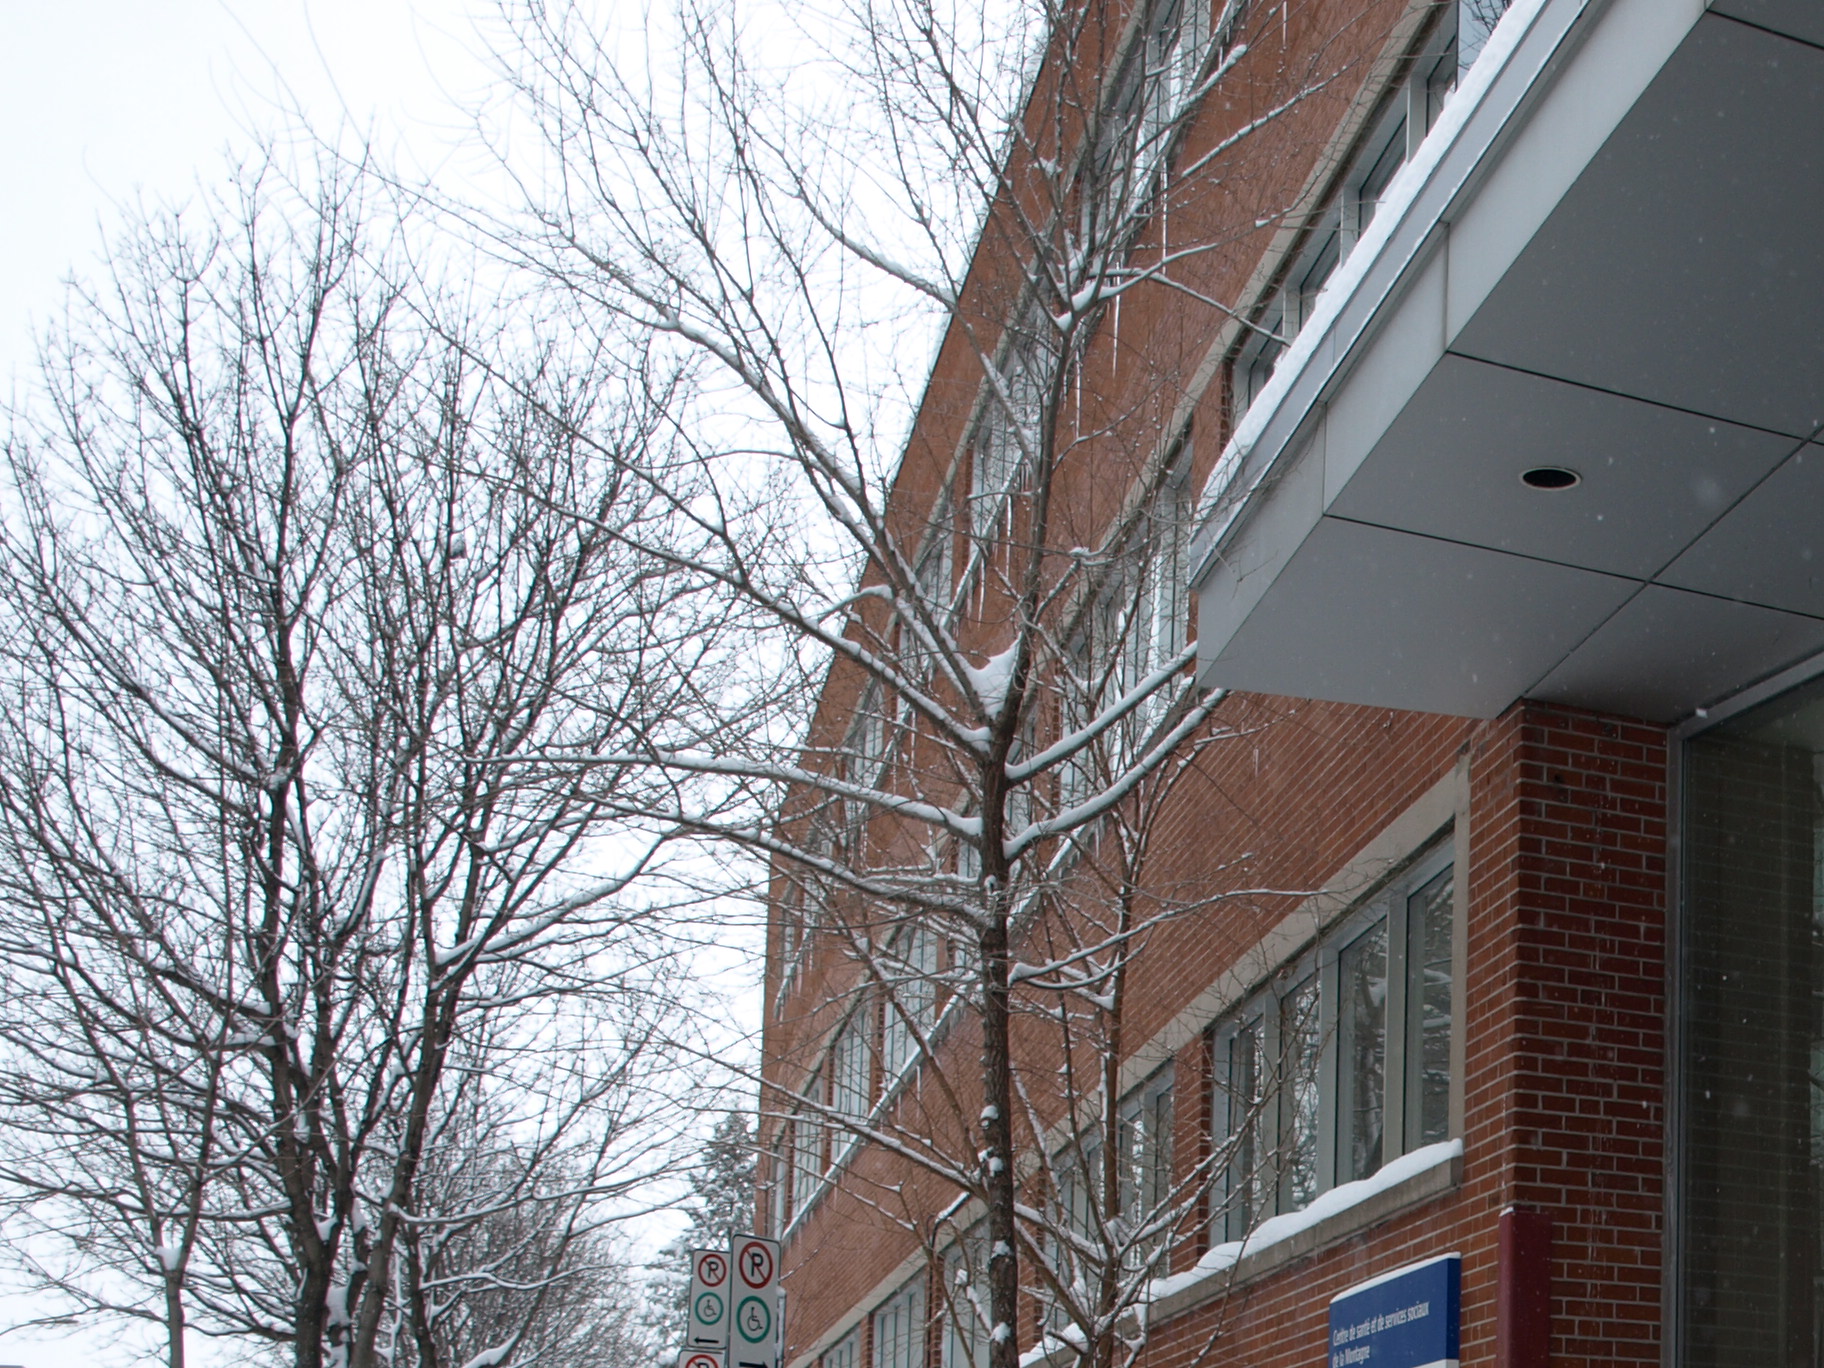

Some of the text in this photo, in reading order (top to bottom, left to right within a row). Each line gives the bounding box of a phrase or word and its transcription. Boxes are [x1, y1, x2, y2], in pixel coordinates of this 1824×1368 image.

[1333, 1327, 1349, 1347] Centre
[1349, 1323, 1356, 1341] de
[1356, 1317, 1370, 1339] santé
[1377, 1313, 1384, 1332] de
[1384, 1308, 1407, 1329] services
[1407, 1301, 1430, 1322] sociaux
[1345, 1345, 1370, 1365] Montagne
